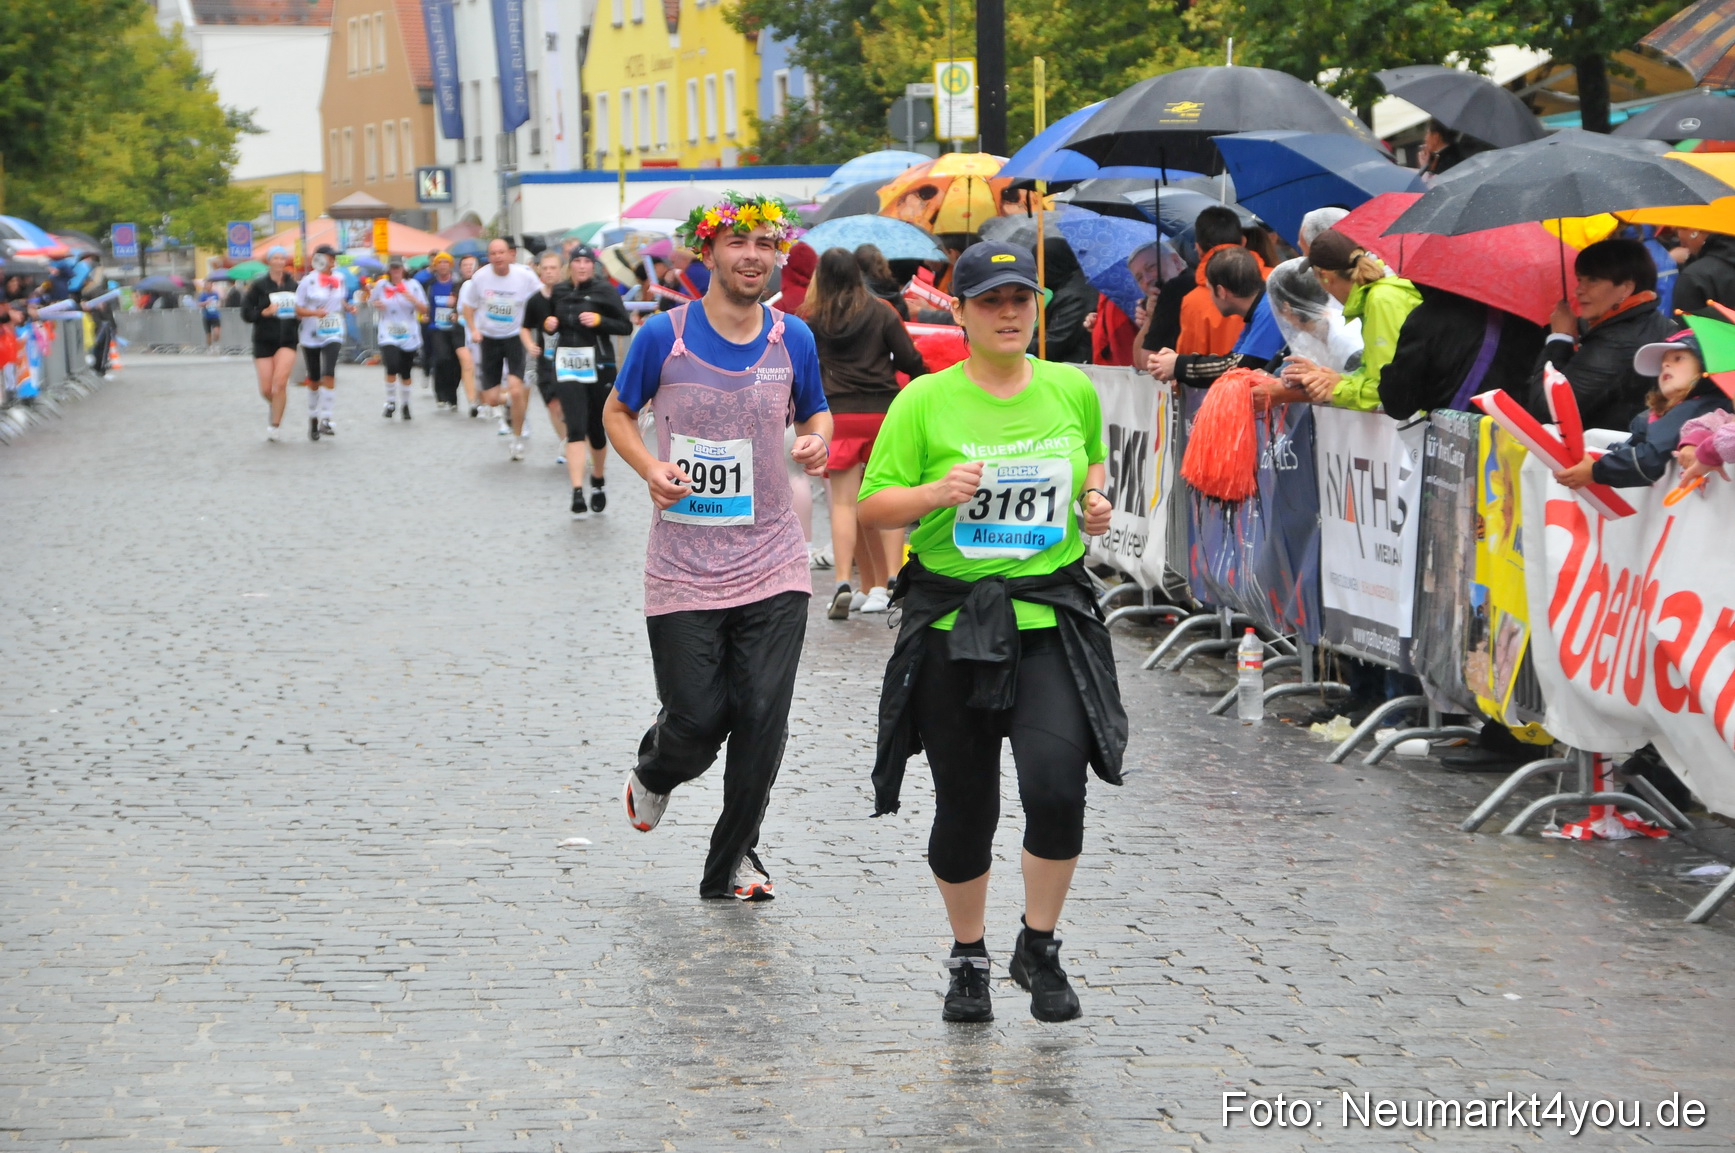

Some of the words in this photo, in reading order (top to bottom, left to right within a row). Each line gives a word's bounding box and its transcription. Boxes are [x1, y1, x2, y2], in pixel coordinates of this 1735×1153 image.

[115, 245, 136, 254] TAXI
[230, 245, 250, 255] TAXI
[693, 444, 727, 456] BOCK
[997, 465, 1038, 477] BOCK
[689, 499, 723, 514] Kevin
[968, 486, 1056, 522] 3181
[972, 528, 1045, 546] Alexandra
